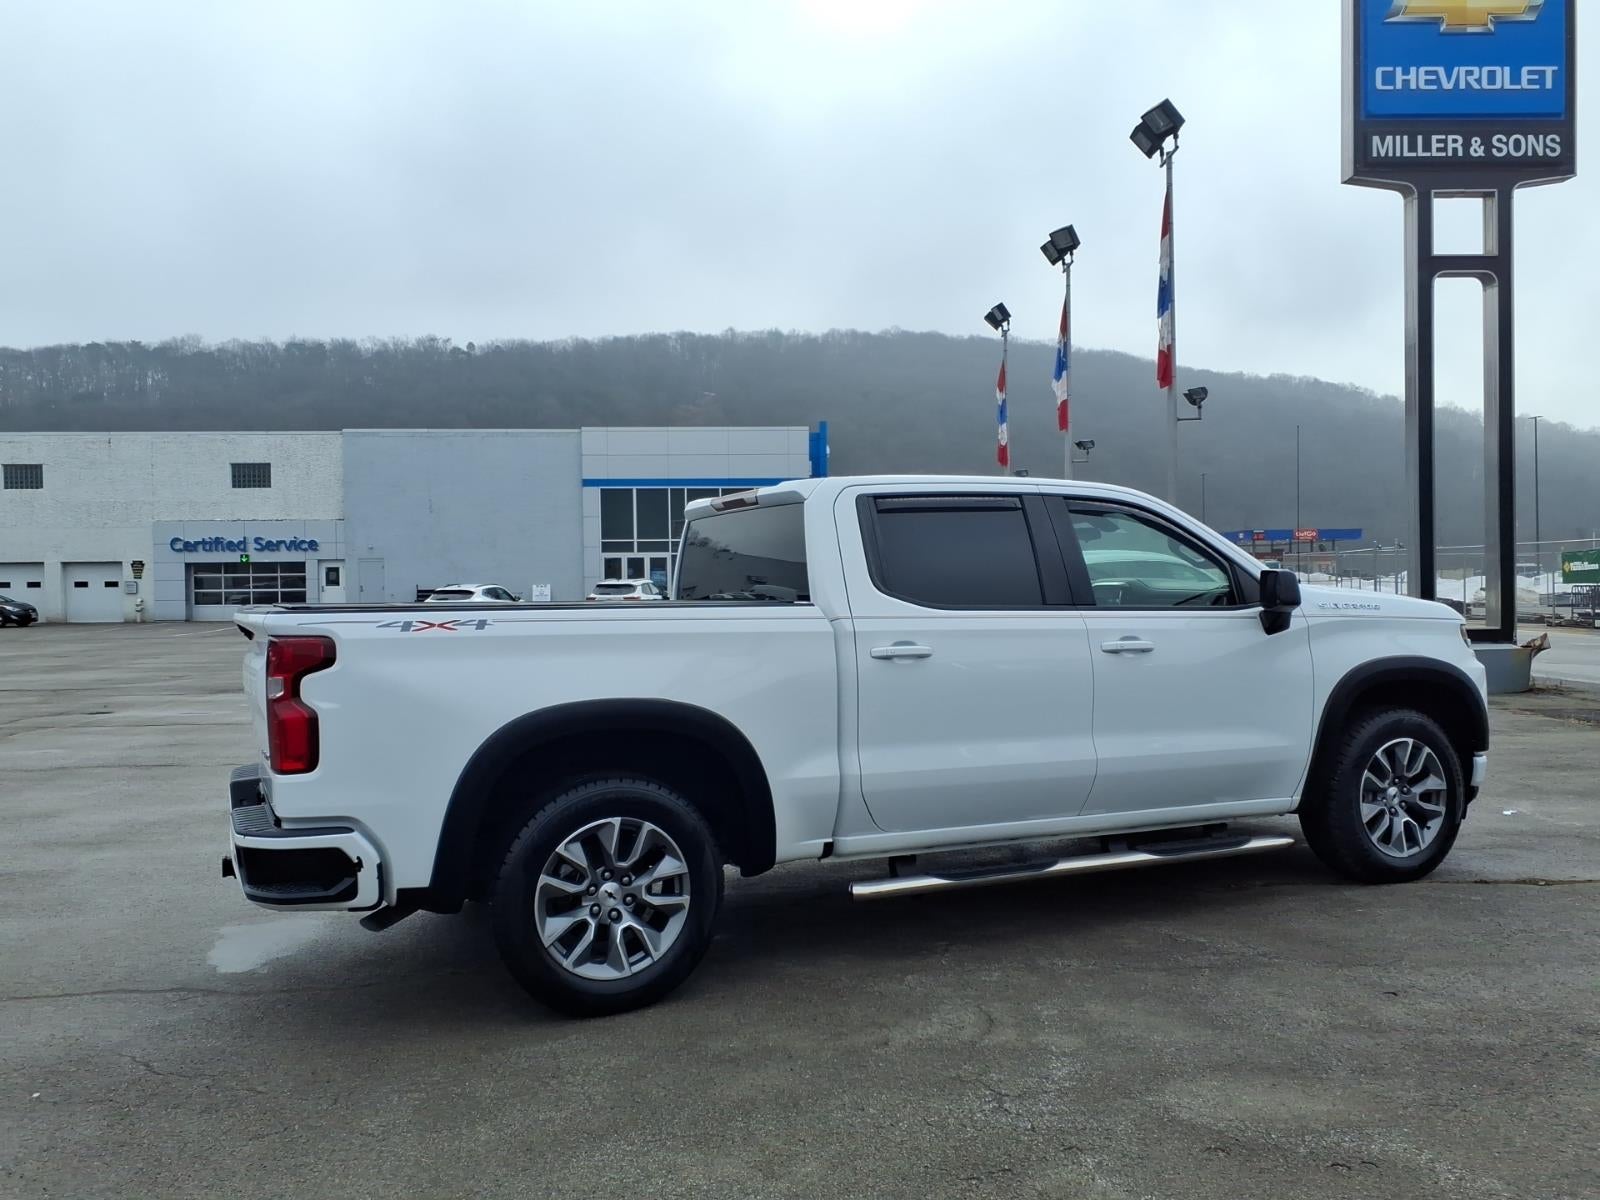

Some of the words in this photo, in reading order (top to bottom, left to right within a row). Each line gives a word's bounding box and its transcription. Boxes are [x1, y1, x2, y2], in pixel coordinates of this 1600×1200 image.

[1375, 66, 1558, 90] CHEVROLET
[1372, 135, 1463, 157] MILLER
[1470, 137, 1485, 156] &
[1491, 134, 1561, 157] SONS
[170, 536, 247, 552] Certified
[253, 536, 319, 552] Service
